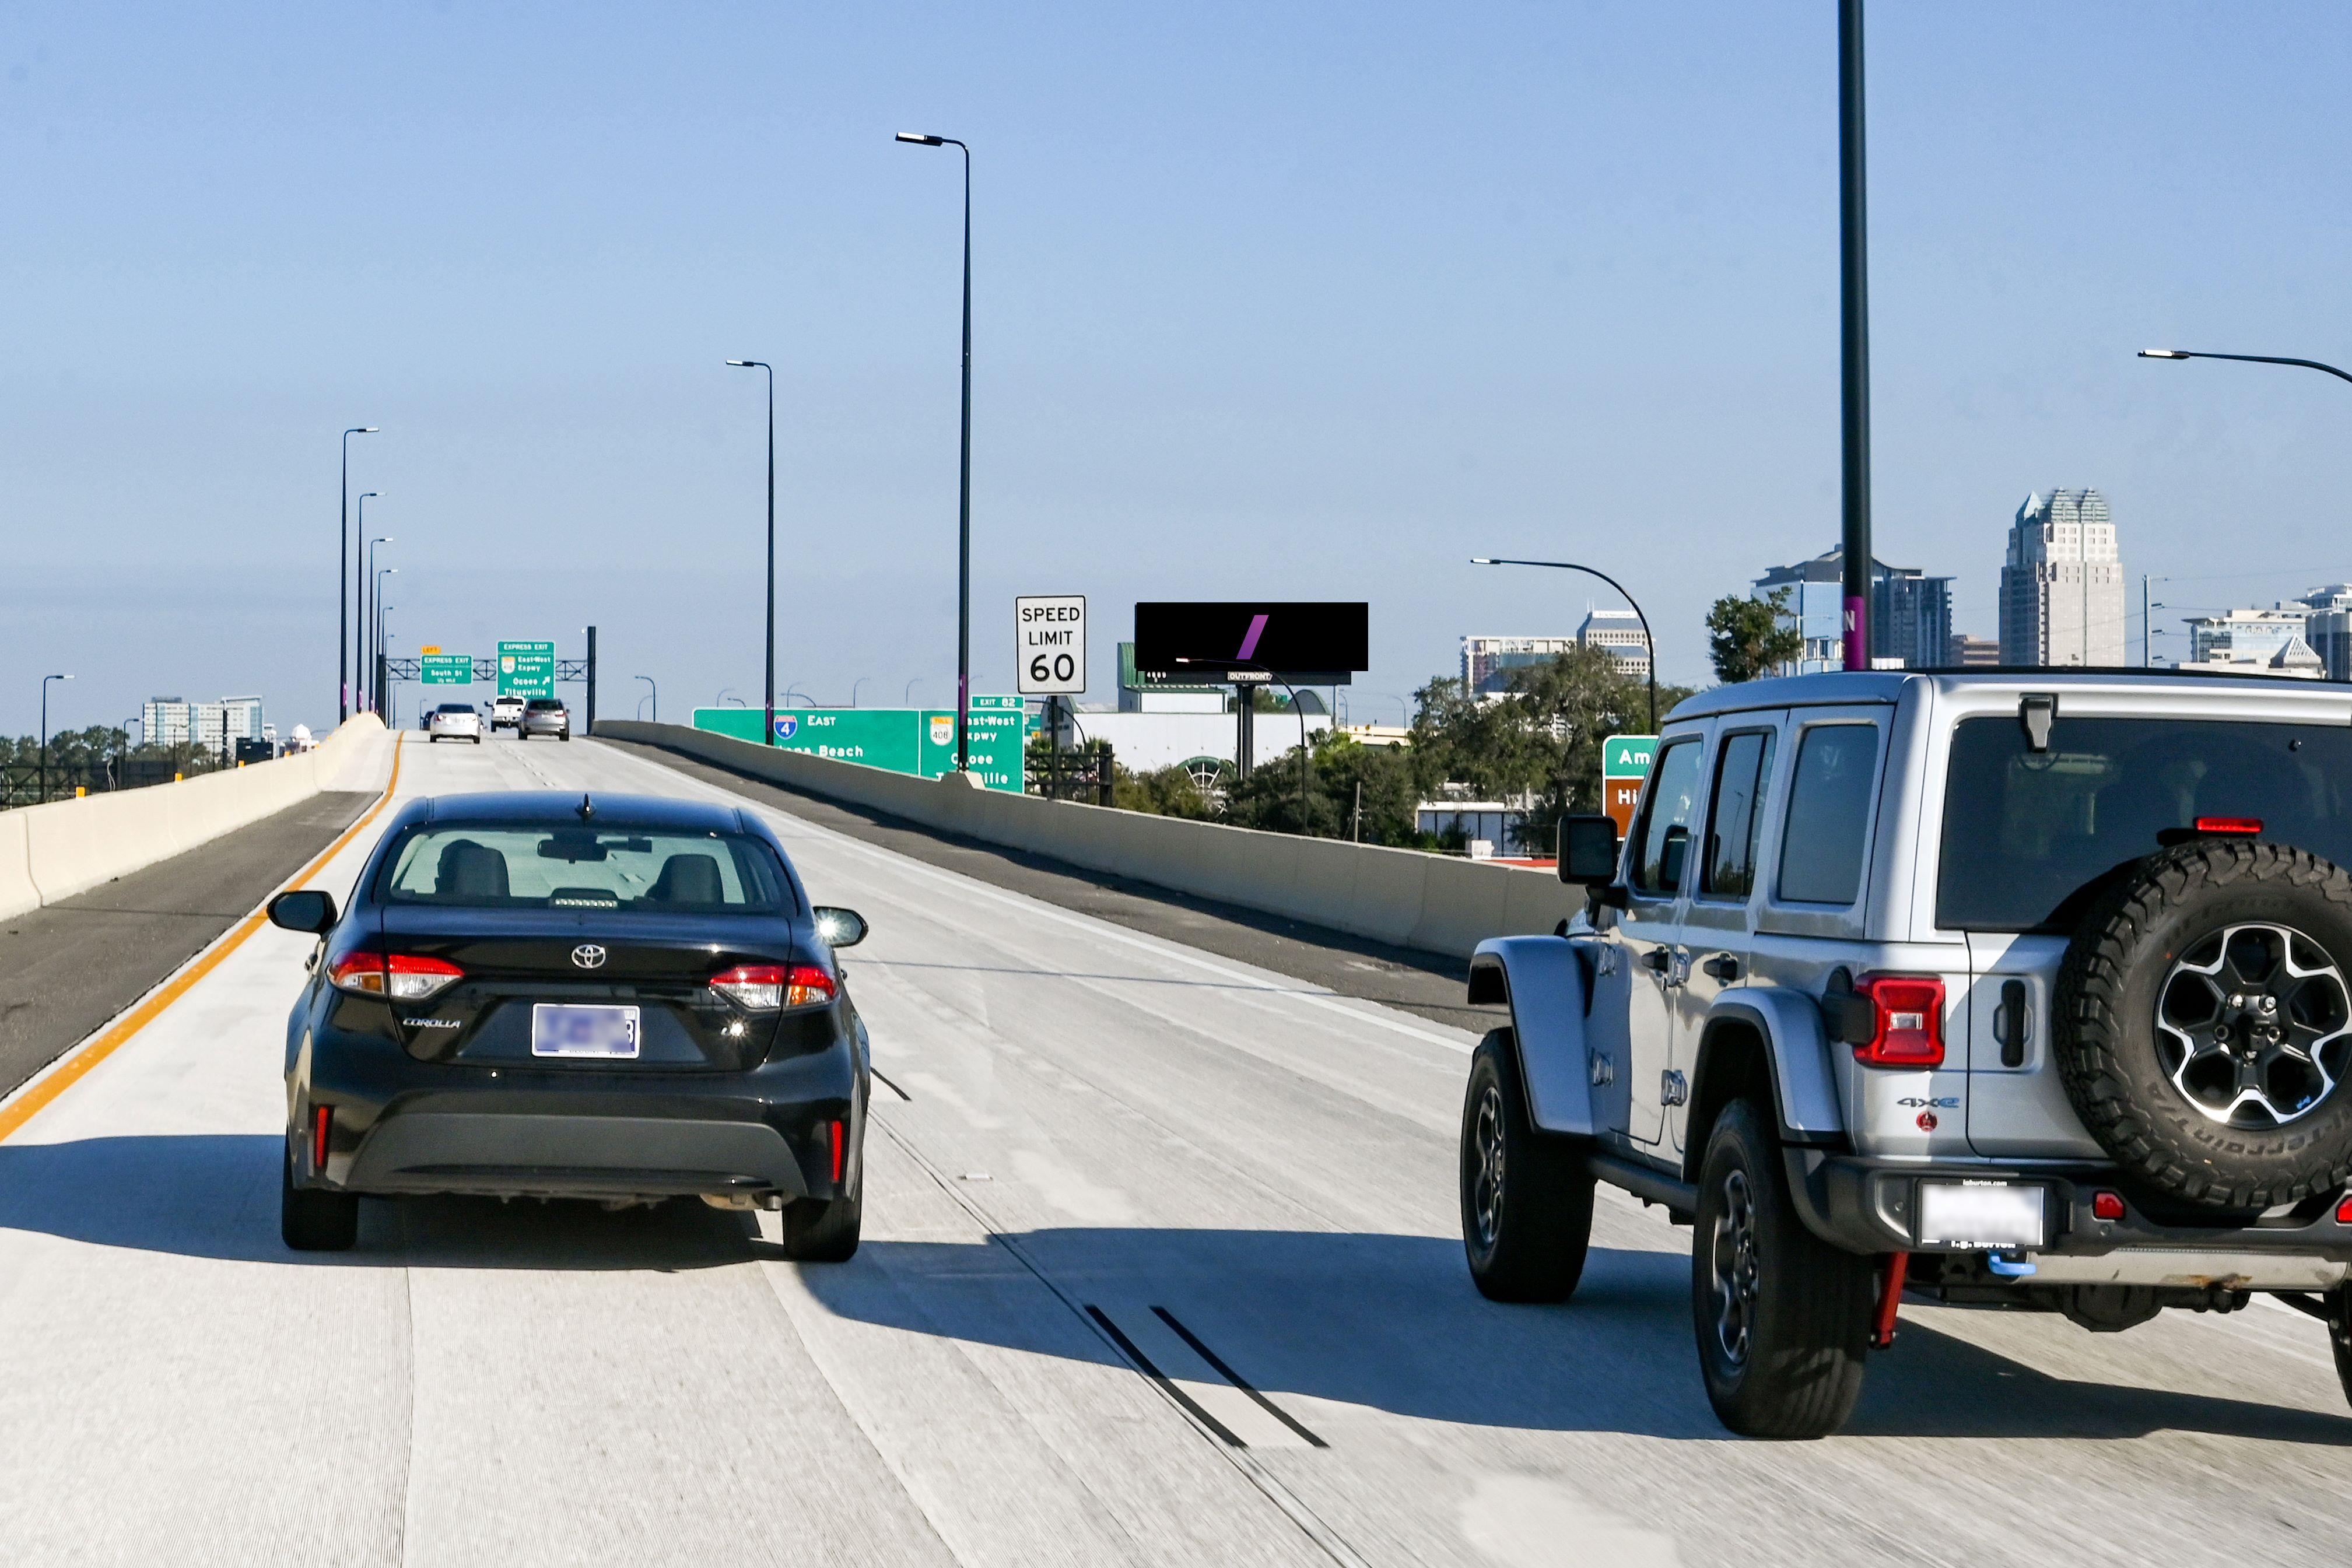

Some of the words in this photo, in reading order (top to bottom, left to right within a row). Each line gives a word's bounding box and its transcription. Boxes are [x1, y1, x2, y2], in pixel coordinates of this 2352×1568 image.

[1022, 607, 1080, 622] SPEED
[1029, 631, 1073, 646] LIMIT
[1030, 654, 1074, 682] 60
[1229, 672, 1271, 680] OUTFRONT
[504, 688, 546, 696] Titusville
[1001, 698, 1016, 707] 82
[968, 716, 1015, 725] ast-West
[780, 722, 790, 735] 4
[968, 732, 997, 742] xpwy
[819, 745, 863, 757] Beach
[1618, 749, 1650, 764] Am
[951, 753, 993, 764] Ooee
[1618, 789, 1638, 805] Hi
[402, 1018, 461, 1029] COROLLA
